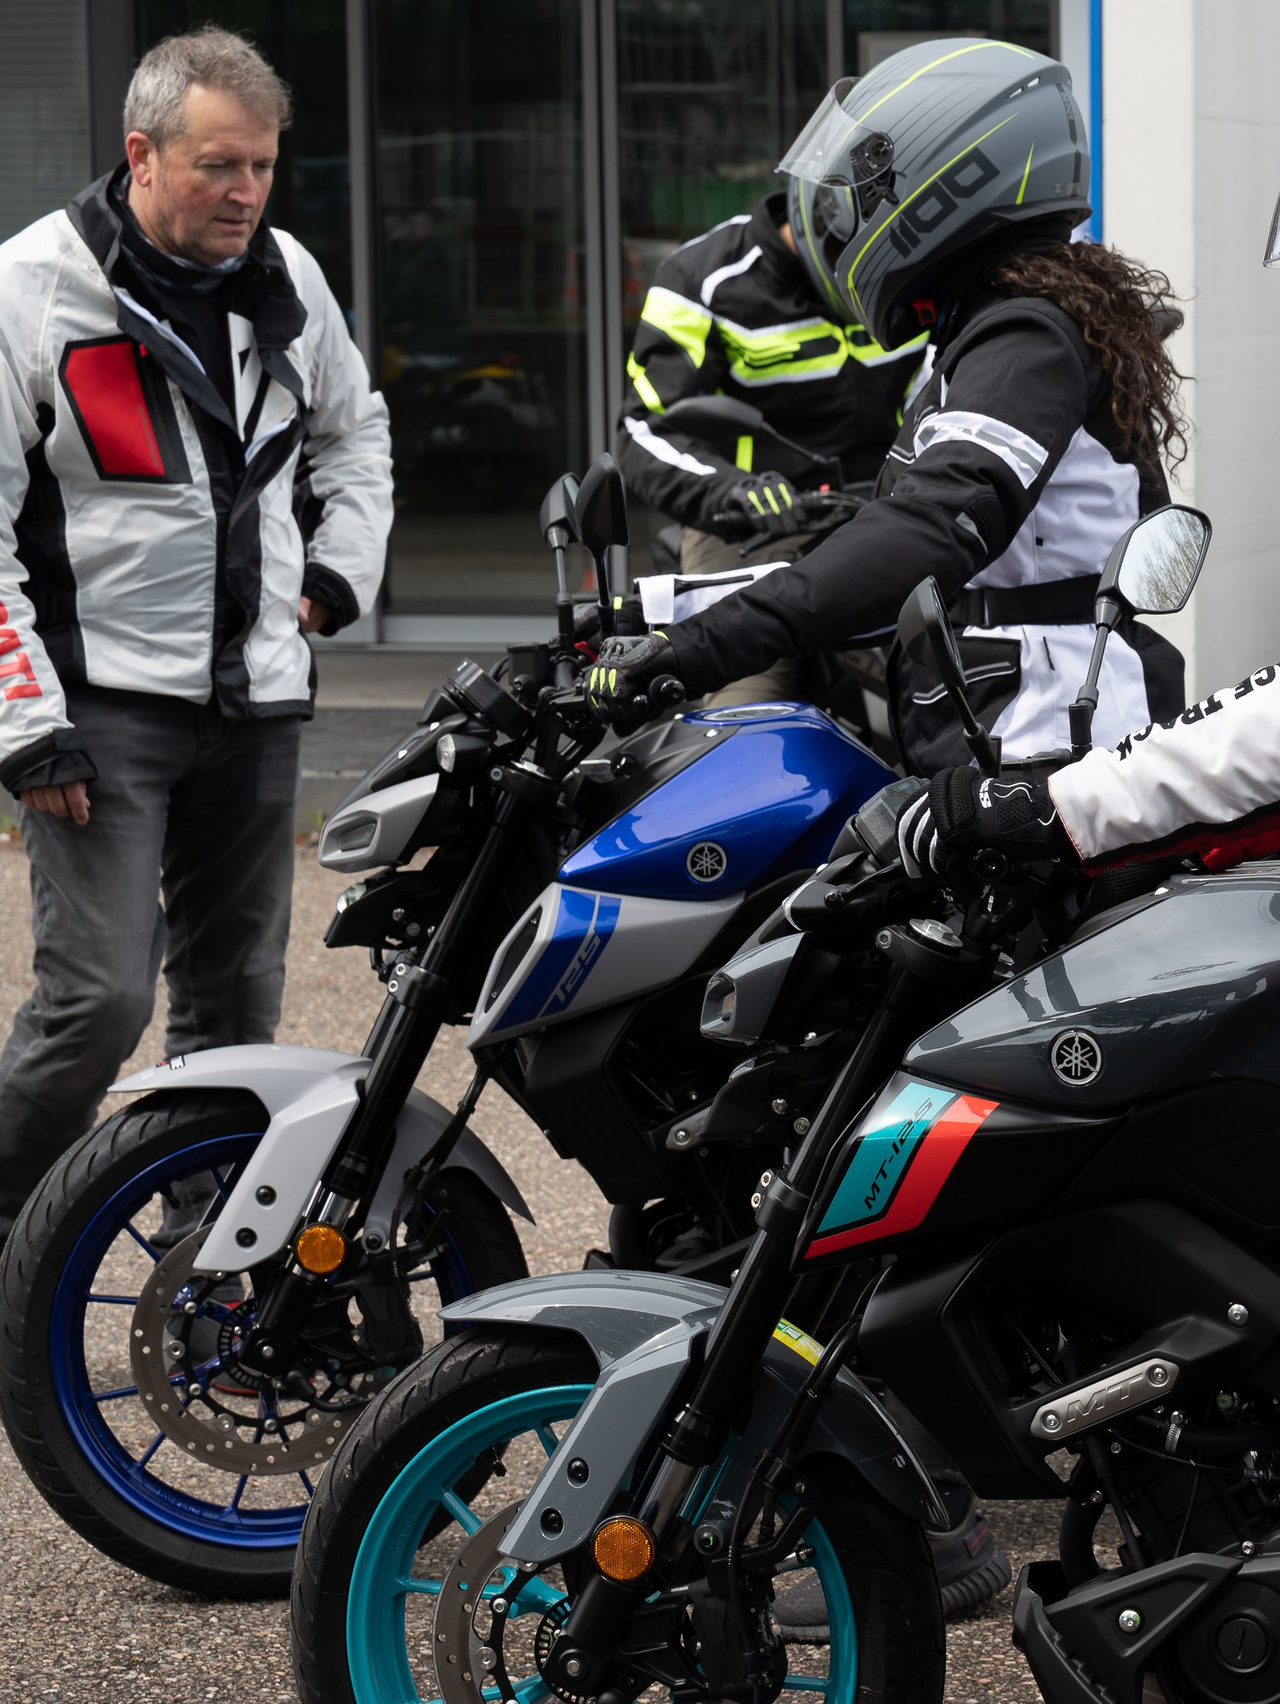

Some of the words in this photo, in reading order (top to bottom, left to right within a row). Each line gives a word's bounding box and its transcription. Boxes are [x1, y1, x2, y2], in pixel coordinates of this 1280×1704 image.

[555, 928, 601, 1003] 125
[864, 1097, 933, 1210] MT-125
[1067, 1372, 1144, 1423] MT
